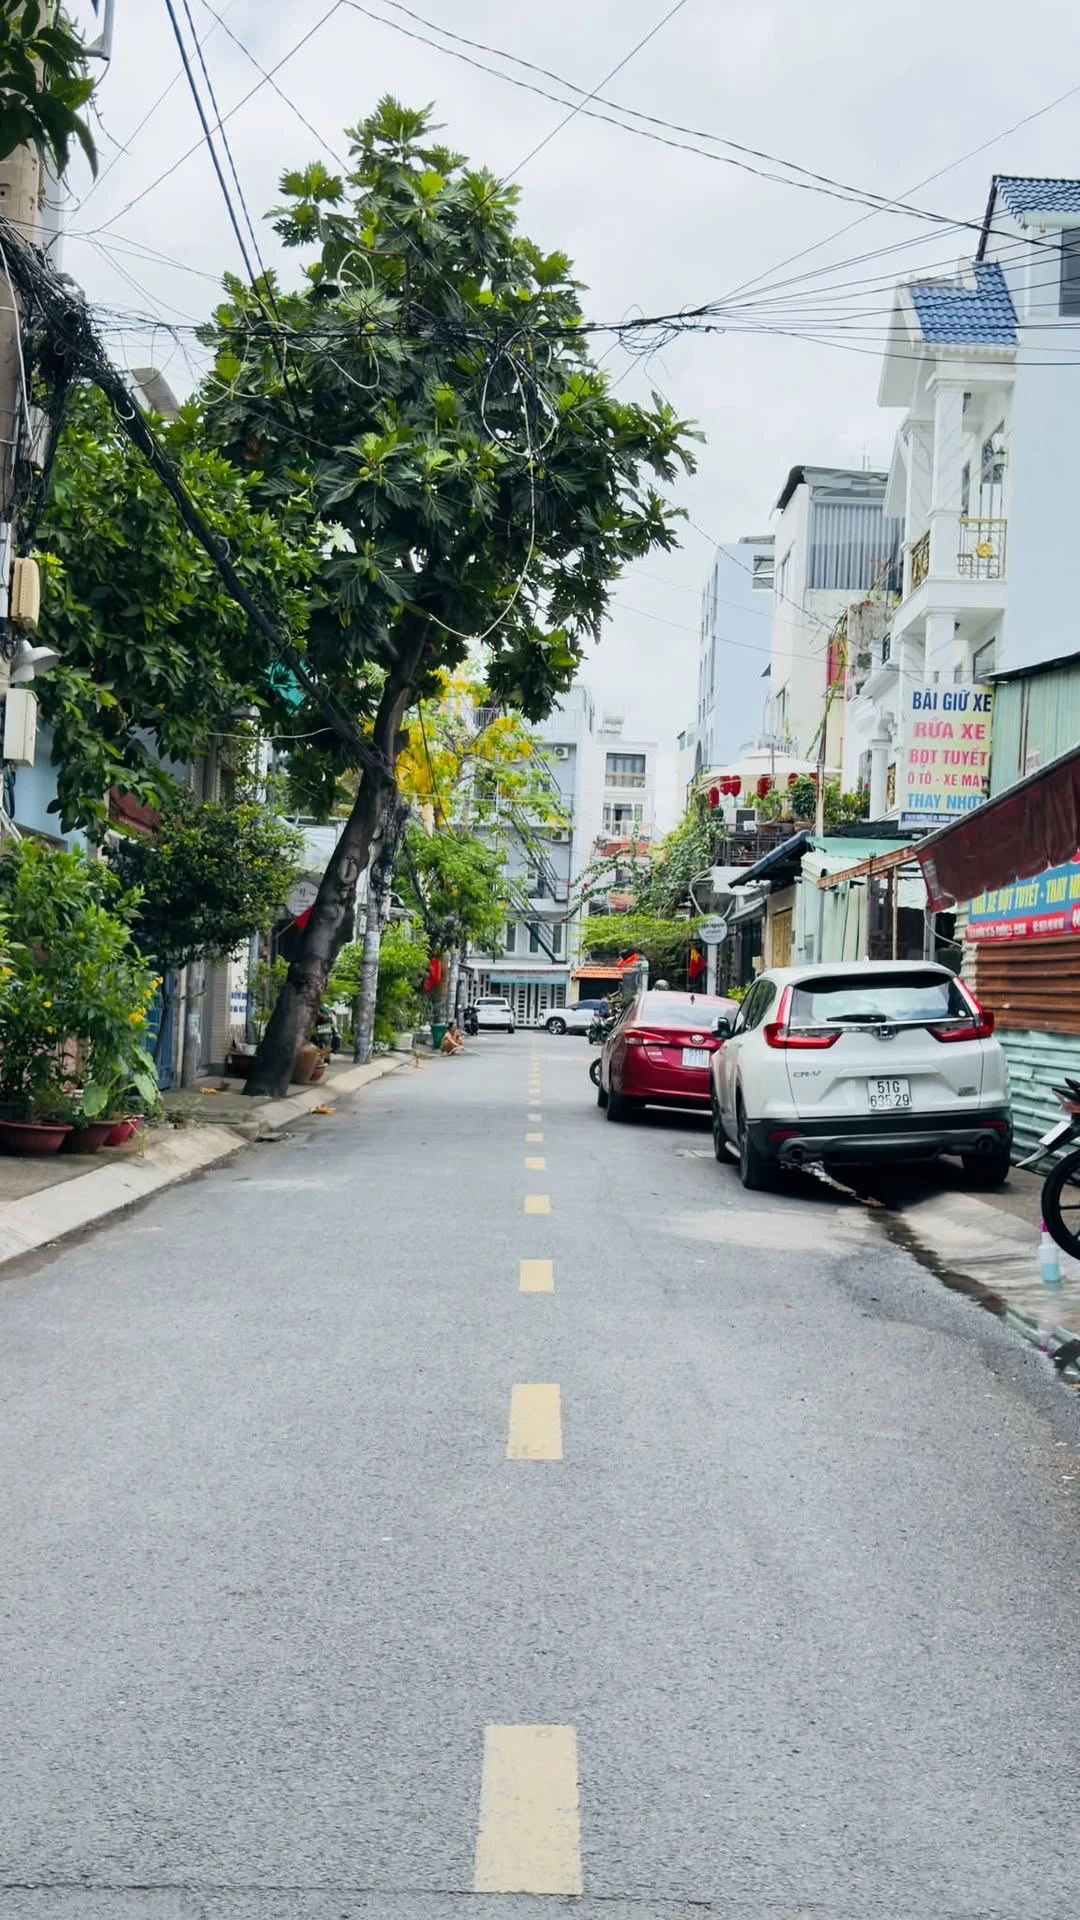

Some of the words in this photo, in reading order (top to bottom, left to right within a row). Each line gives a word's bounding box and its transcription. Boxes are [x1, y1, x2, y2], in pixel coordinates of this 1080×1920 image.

[912, 688, 937, 710] BÃI
[942, 689, 970, 711] GIỮ
[973, 694, 992, 712] XE
[961, 723, 985, 740] XE
[944, 773, 957, 787] XE
[907, 793, 942, 809] THAY
[793, 1070, 821, 1078] CR-V
[877, 1080, 900, 1094] 51G
